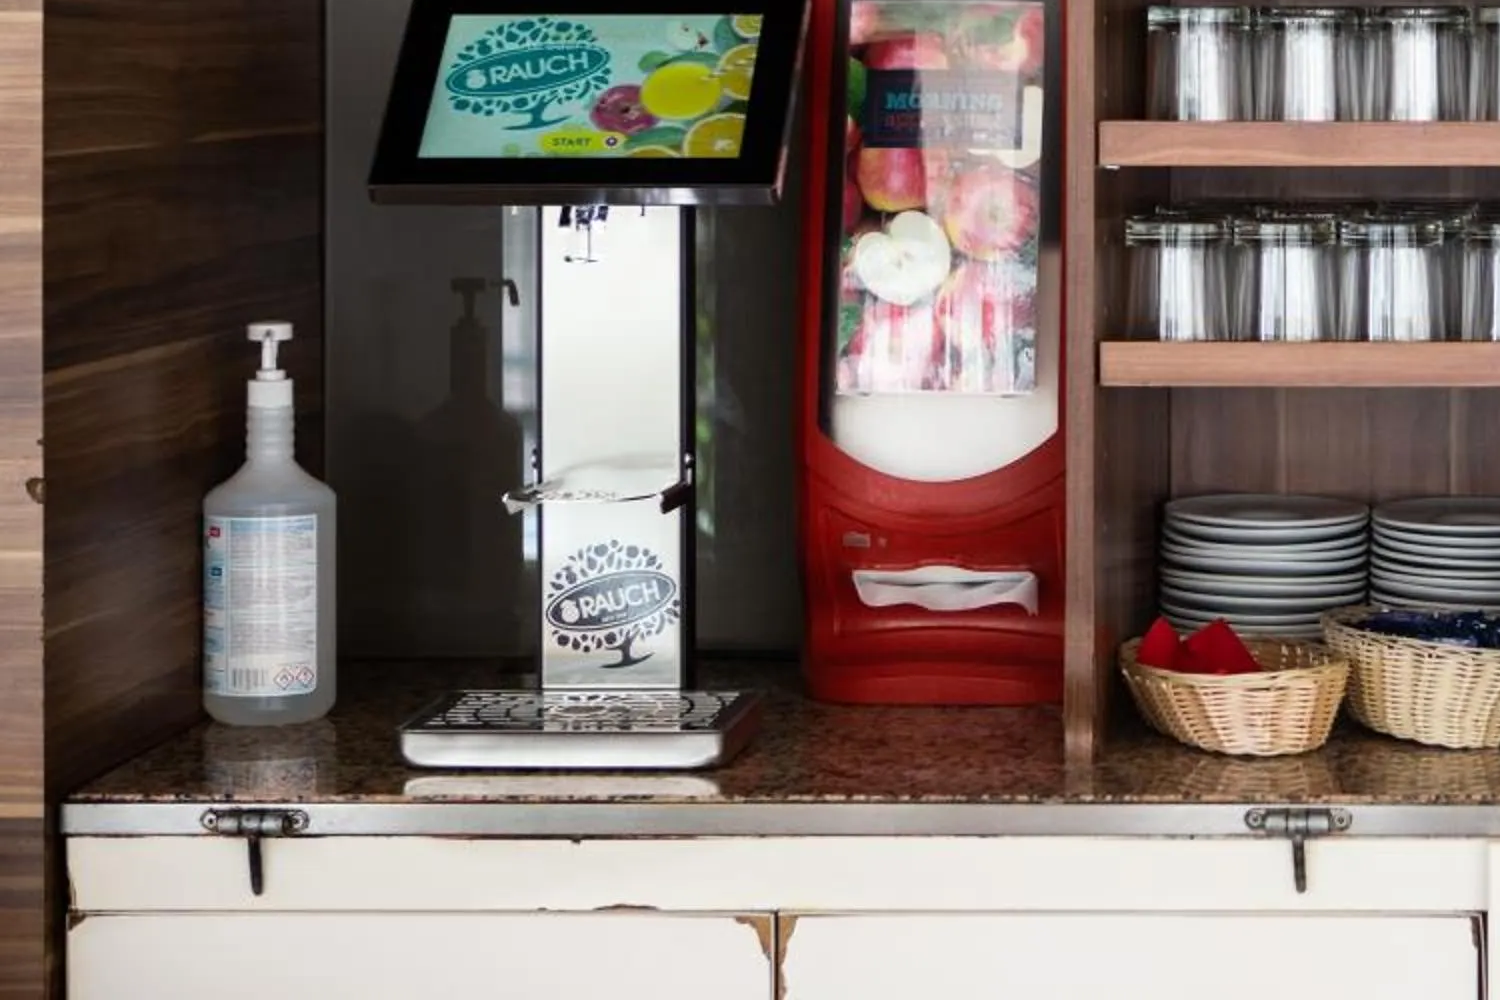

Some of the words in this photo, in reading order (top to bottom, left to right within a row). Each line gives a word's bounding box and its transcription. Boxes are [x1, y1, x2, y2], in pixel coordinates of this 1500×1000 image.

[489, 50, 590, 87] RAUCH
[551, 136, 591, 147] START
[579, 580, 661, 619] RAUCH
